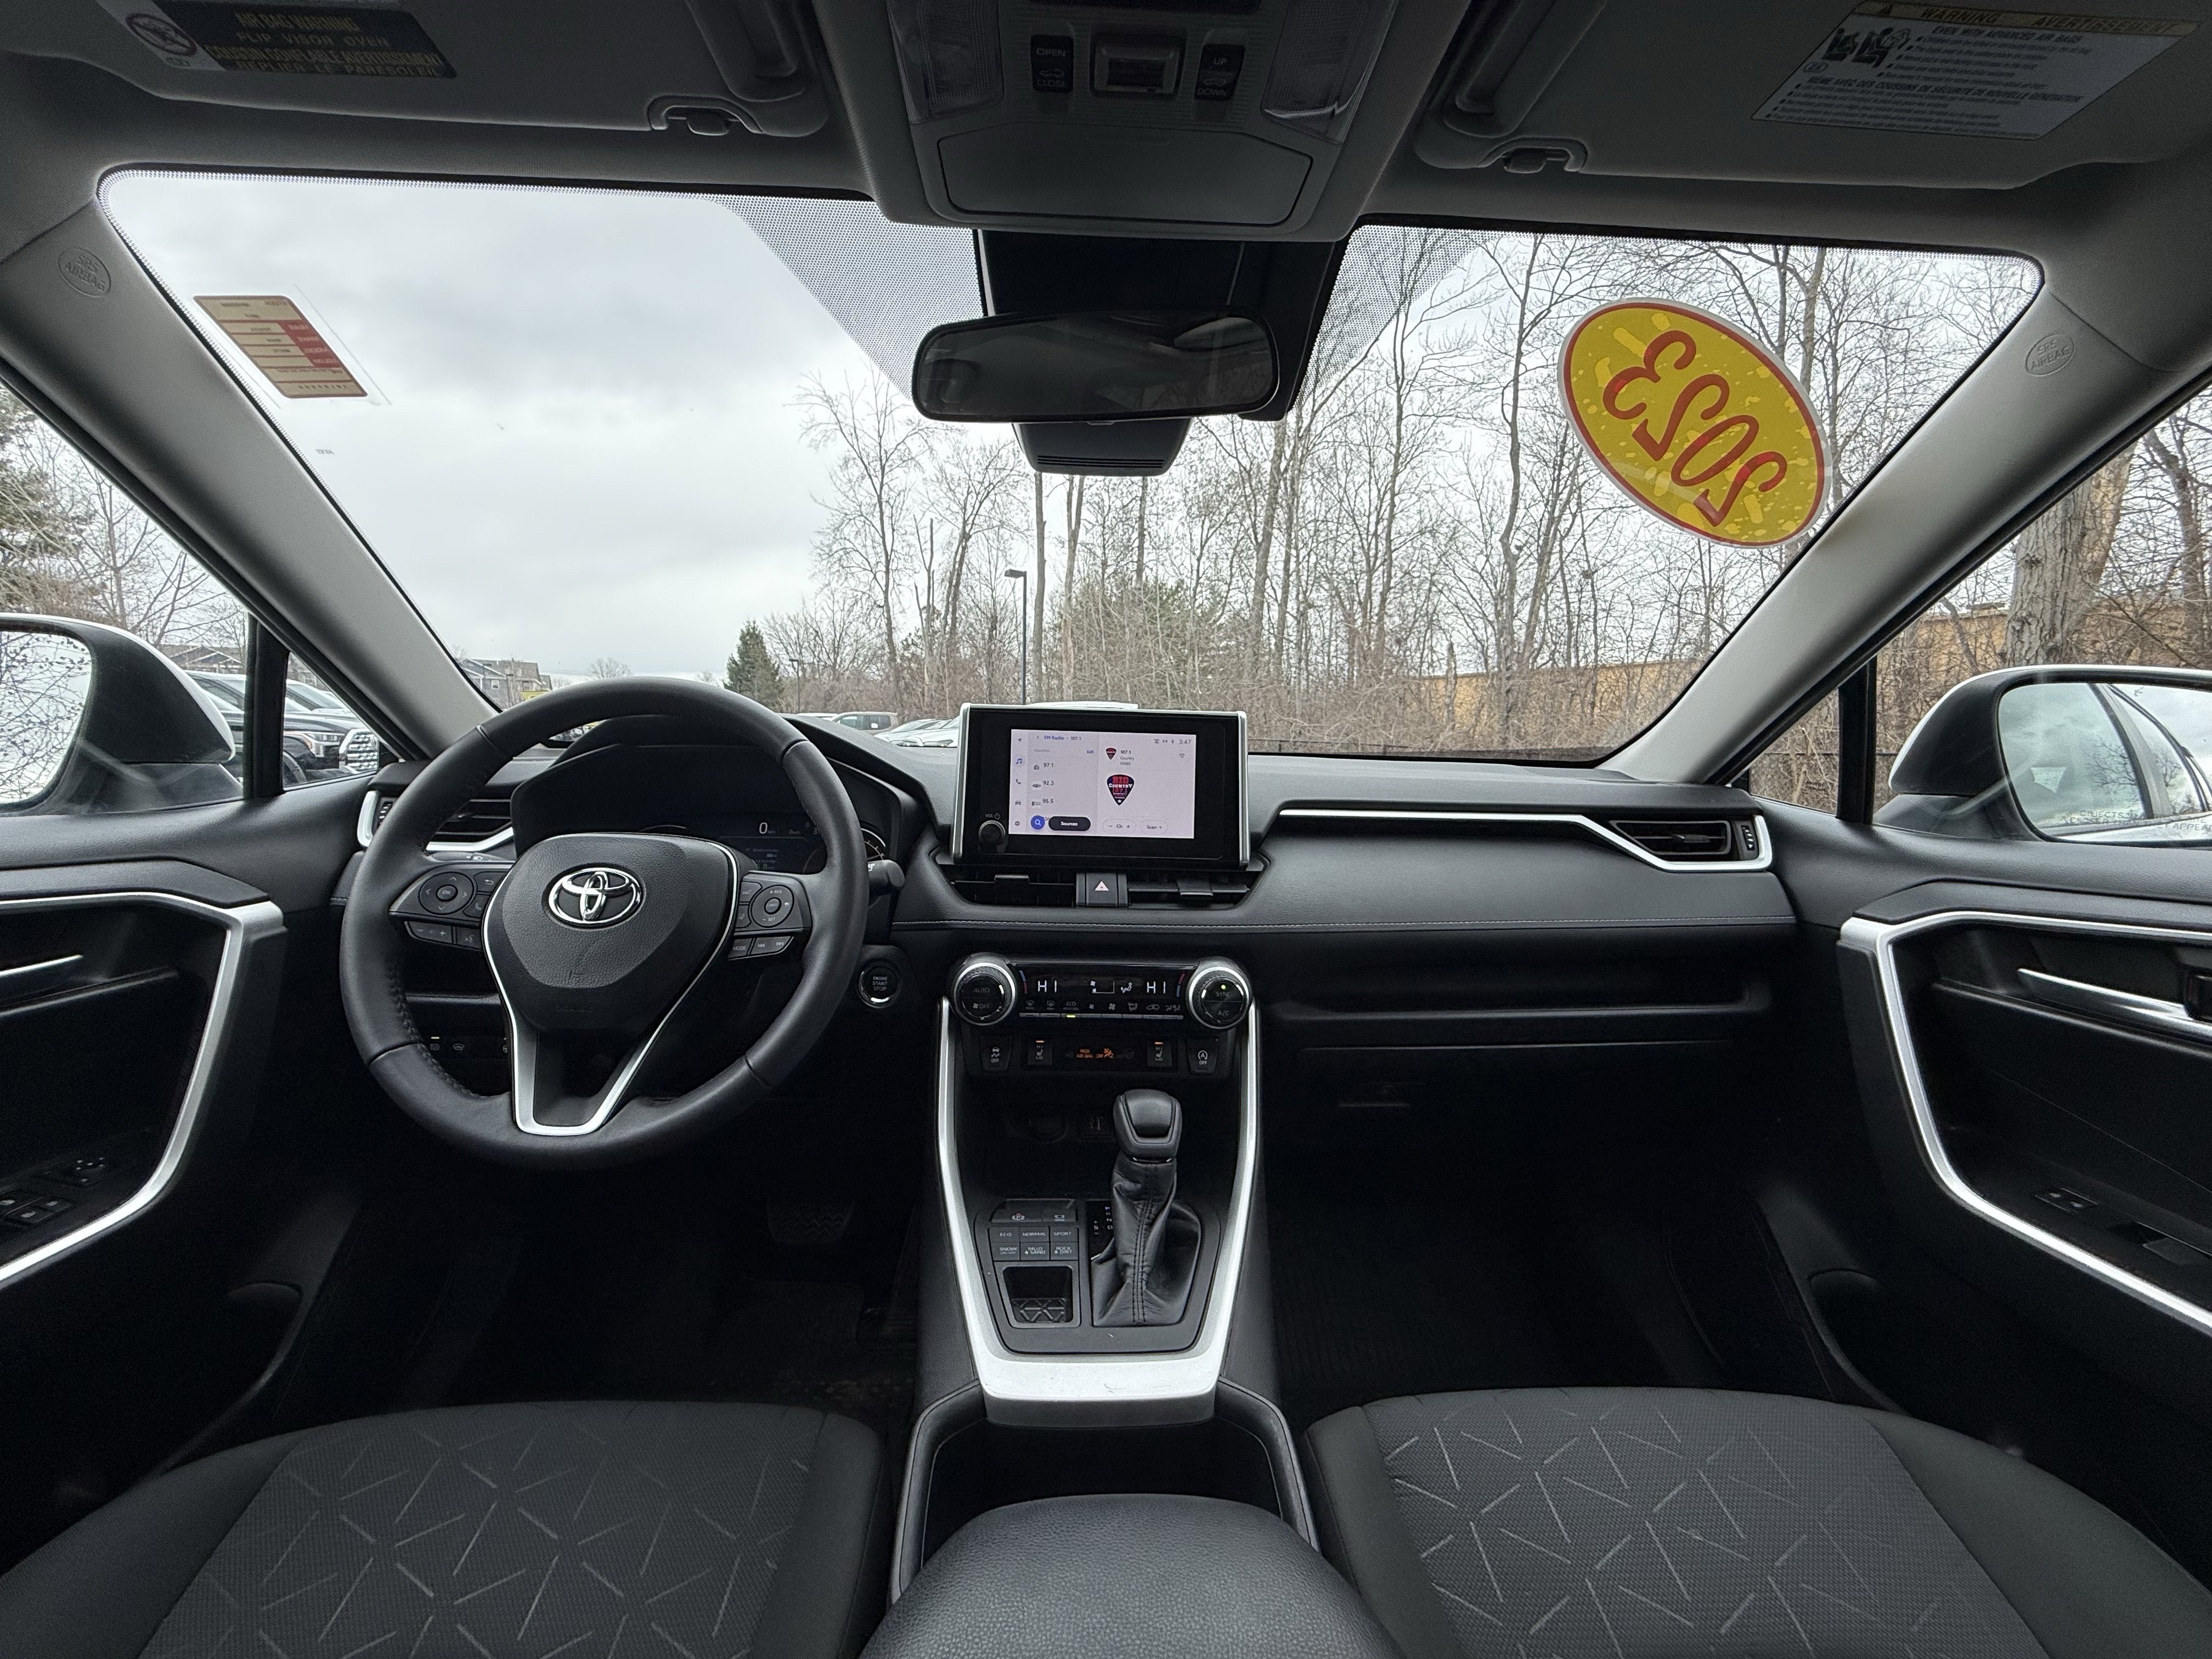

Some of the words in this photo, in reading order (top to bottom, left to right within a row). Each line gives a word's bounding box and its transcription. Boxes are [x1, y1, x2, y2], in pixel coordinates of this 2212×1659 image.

[1921, 8, 2001, 23] WARNING
[236, 31, 272, 43] FLIP
[281, 32, 334, 46] VISOR
[342, 35, 389, 47] OVER
[1036, 48, 1066, 57] OPEN
[1037, 79, 1067, 88] CLOSE
[1197, 88, 1228, 97] DOWN
[759, 822, 768, 834] 0
[1037, 979, 1058, 993] HI
[1147, 980, 1166, 994] HI
